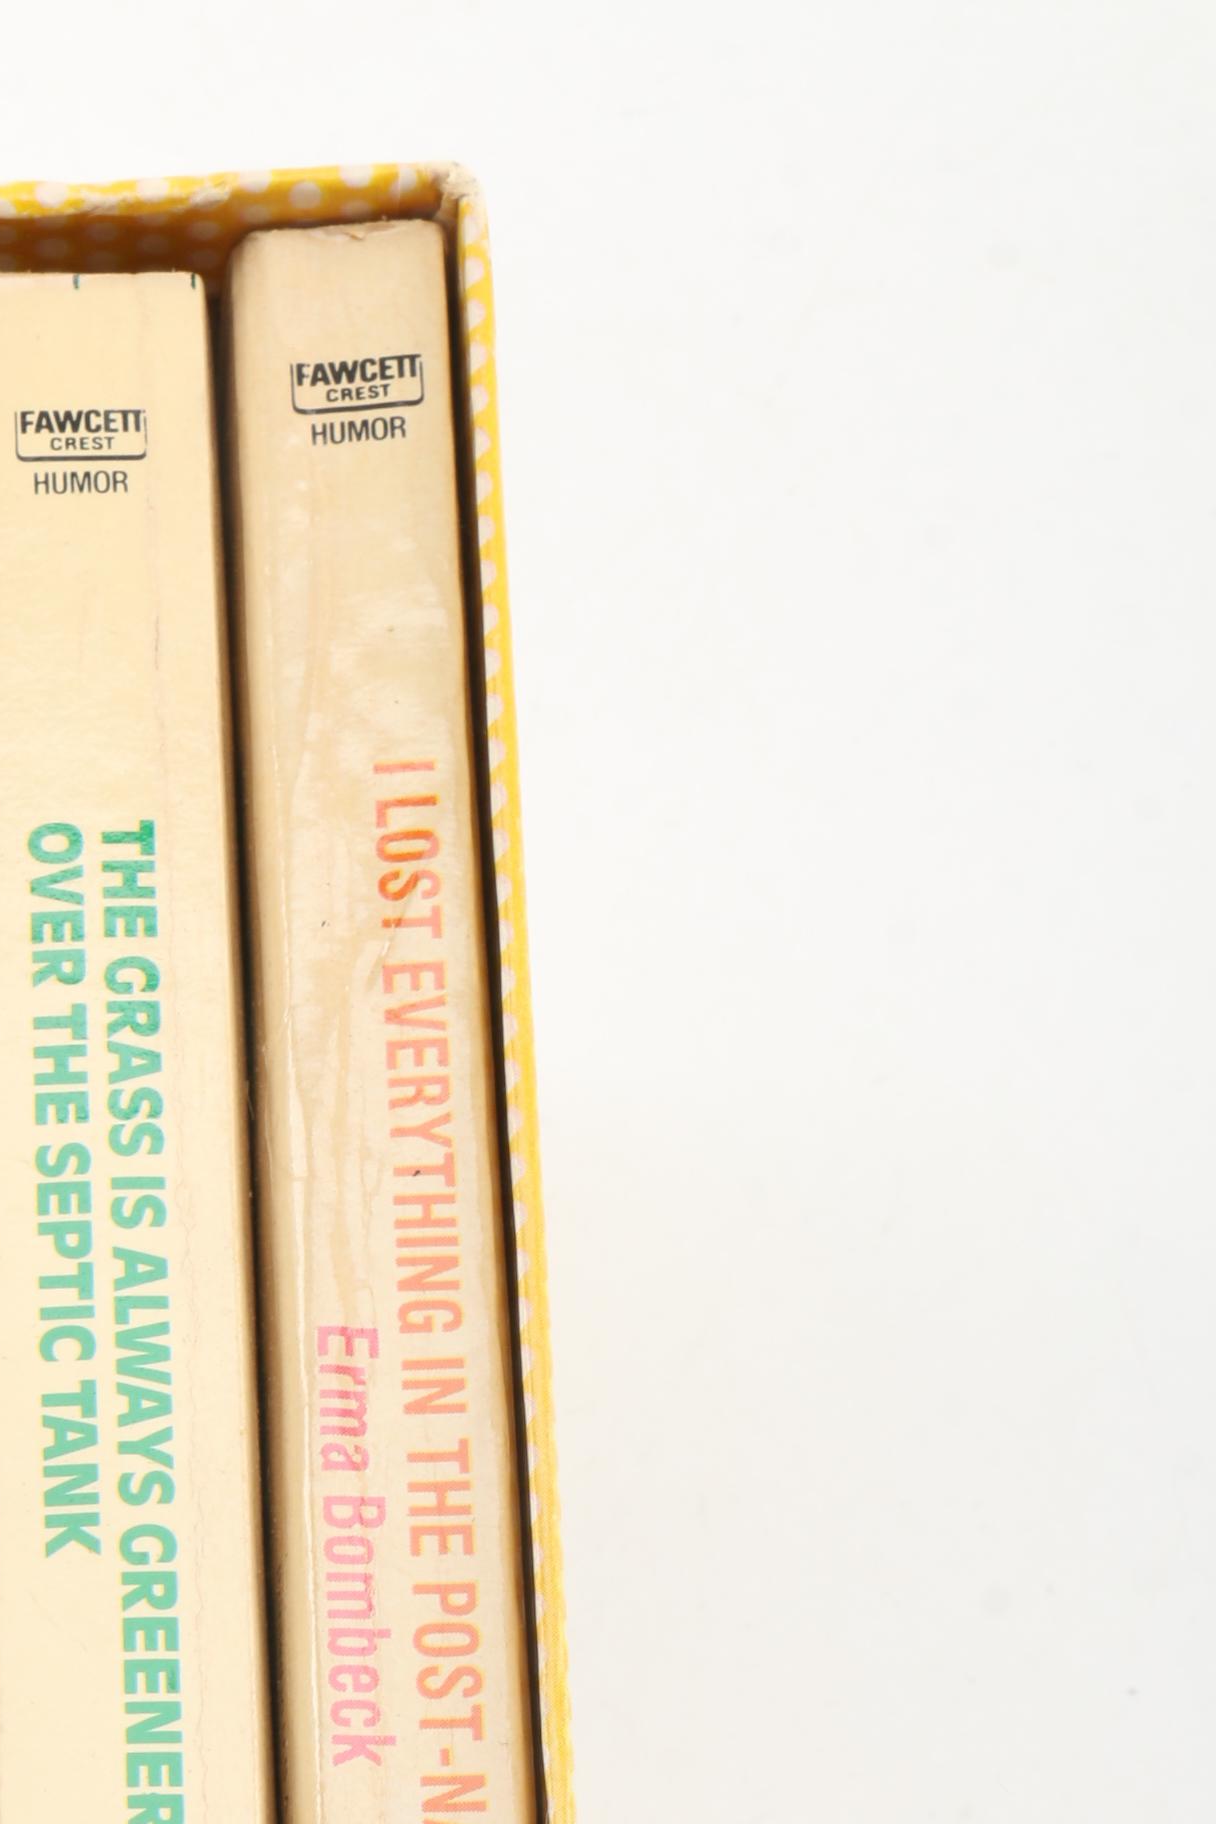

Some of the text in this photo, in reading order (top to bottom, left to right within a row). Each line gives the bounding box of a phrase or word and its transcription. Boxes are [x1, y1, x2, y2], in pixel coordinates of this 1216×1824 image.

[296, 354, 421, 386] FAWCETT
[326, 384, 390, 402] CREST
[20, 409, 145, 434] FAWCETT
[50, 437, 115, 450] CREST
[311, 416, 407, 446] HUMOR
[34, 470, 128, 494] HUMOR
[373, 760, 436, 774] I
[100, 819, 158, 938] THE
[375, 796, 443, 940] LOST
[104, 955, 165, 1157] GRASS
[382, 961, 464, 1337] EVERYTHING
[27, 822, 101, 1558] OVER THE SEPTIC TANK
[110, 1176, 167, 1229] IS
[112, 1247, 175, 1506] ALWAYS
[401, 1357, 468, 1415] IN
[406, 1438, 476, 1557] THE
[316, 1324, 397, 1767] Erma Bombeck
